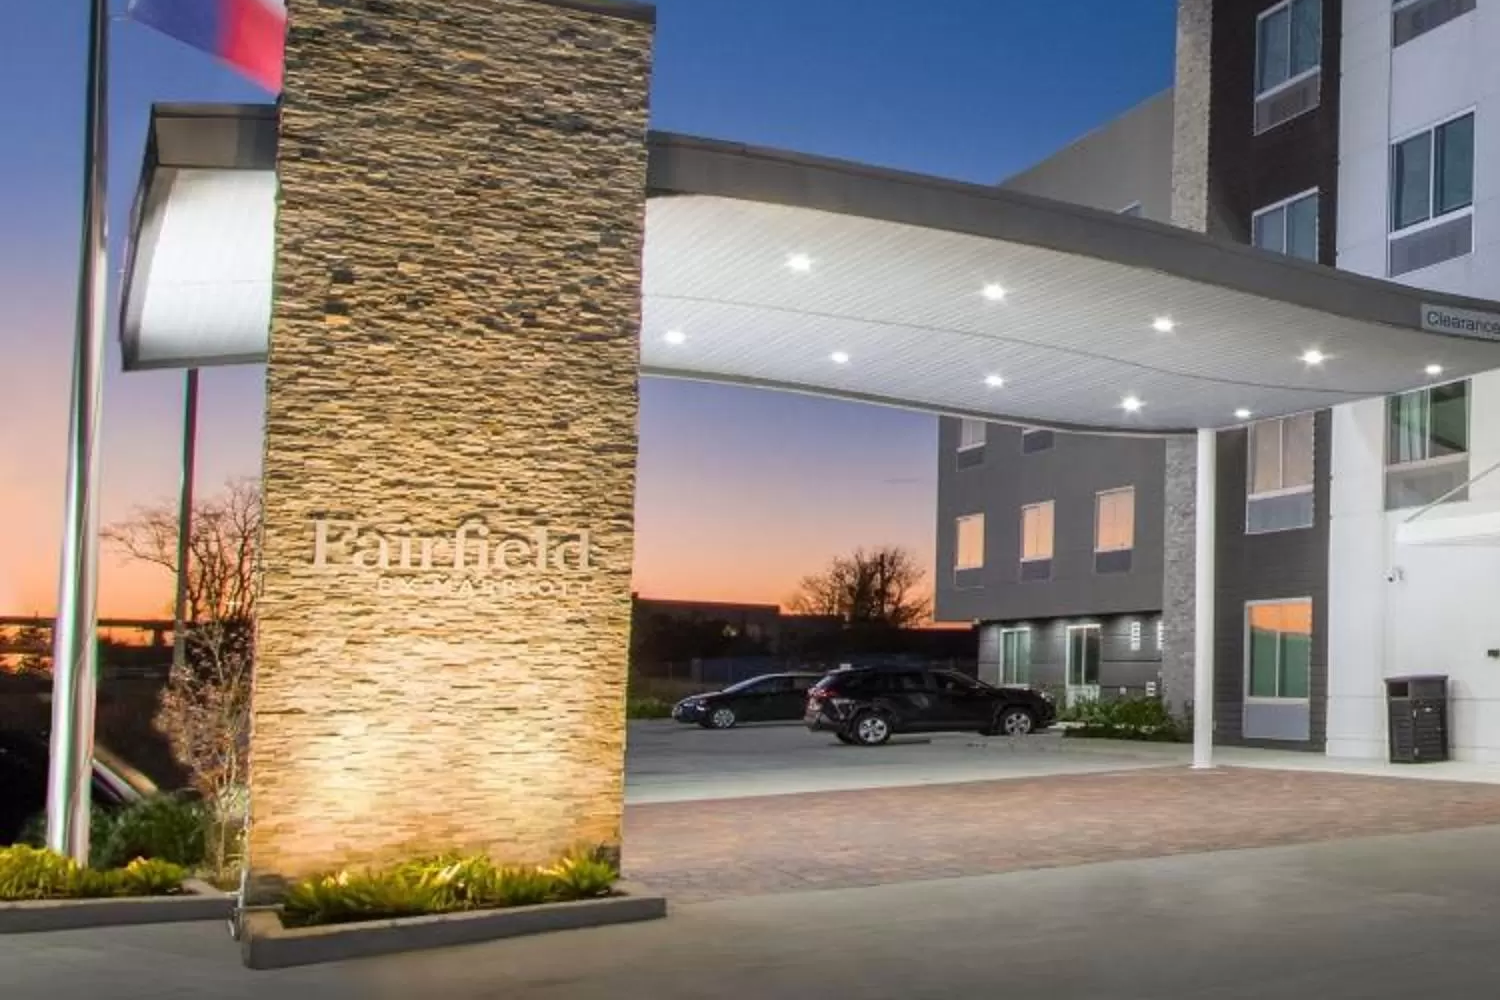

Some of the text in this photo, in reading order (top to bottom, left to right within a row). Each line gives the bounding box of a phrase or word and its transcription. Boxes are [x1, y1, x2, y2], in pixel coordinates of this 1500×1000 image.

[1427, 311, 1500, 336] Clearance
[305, 517, 600, 572] Fairfield
[376, 576, 415, 596] BY
